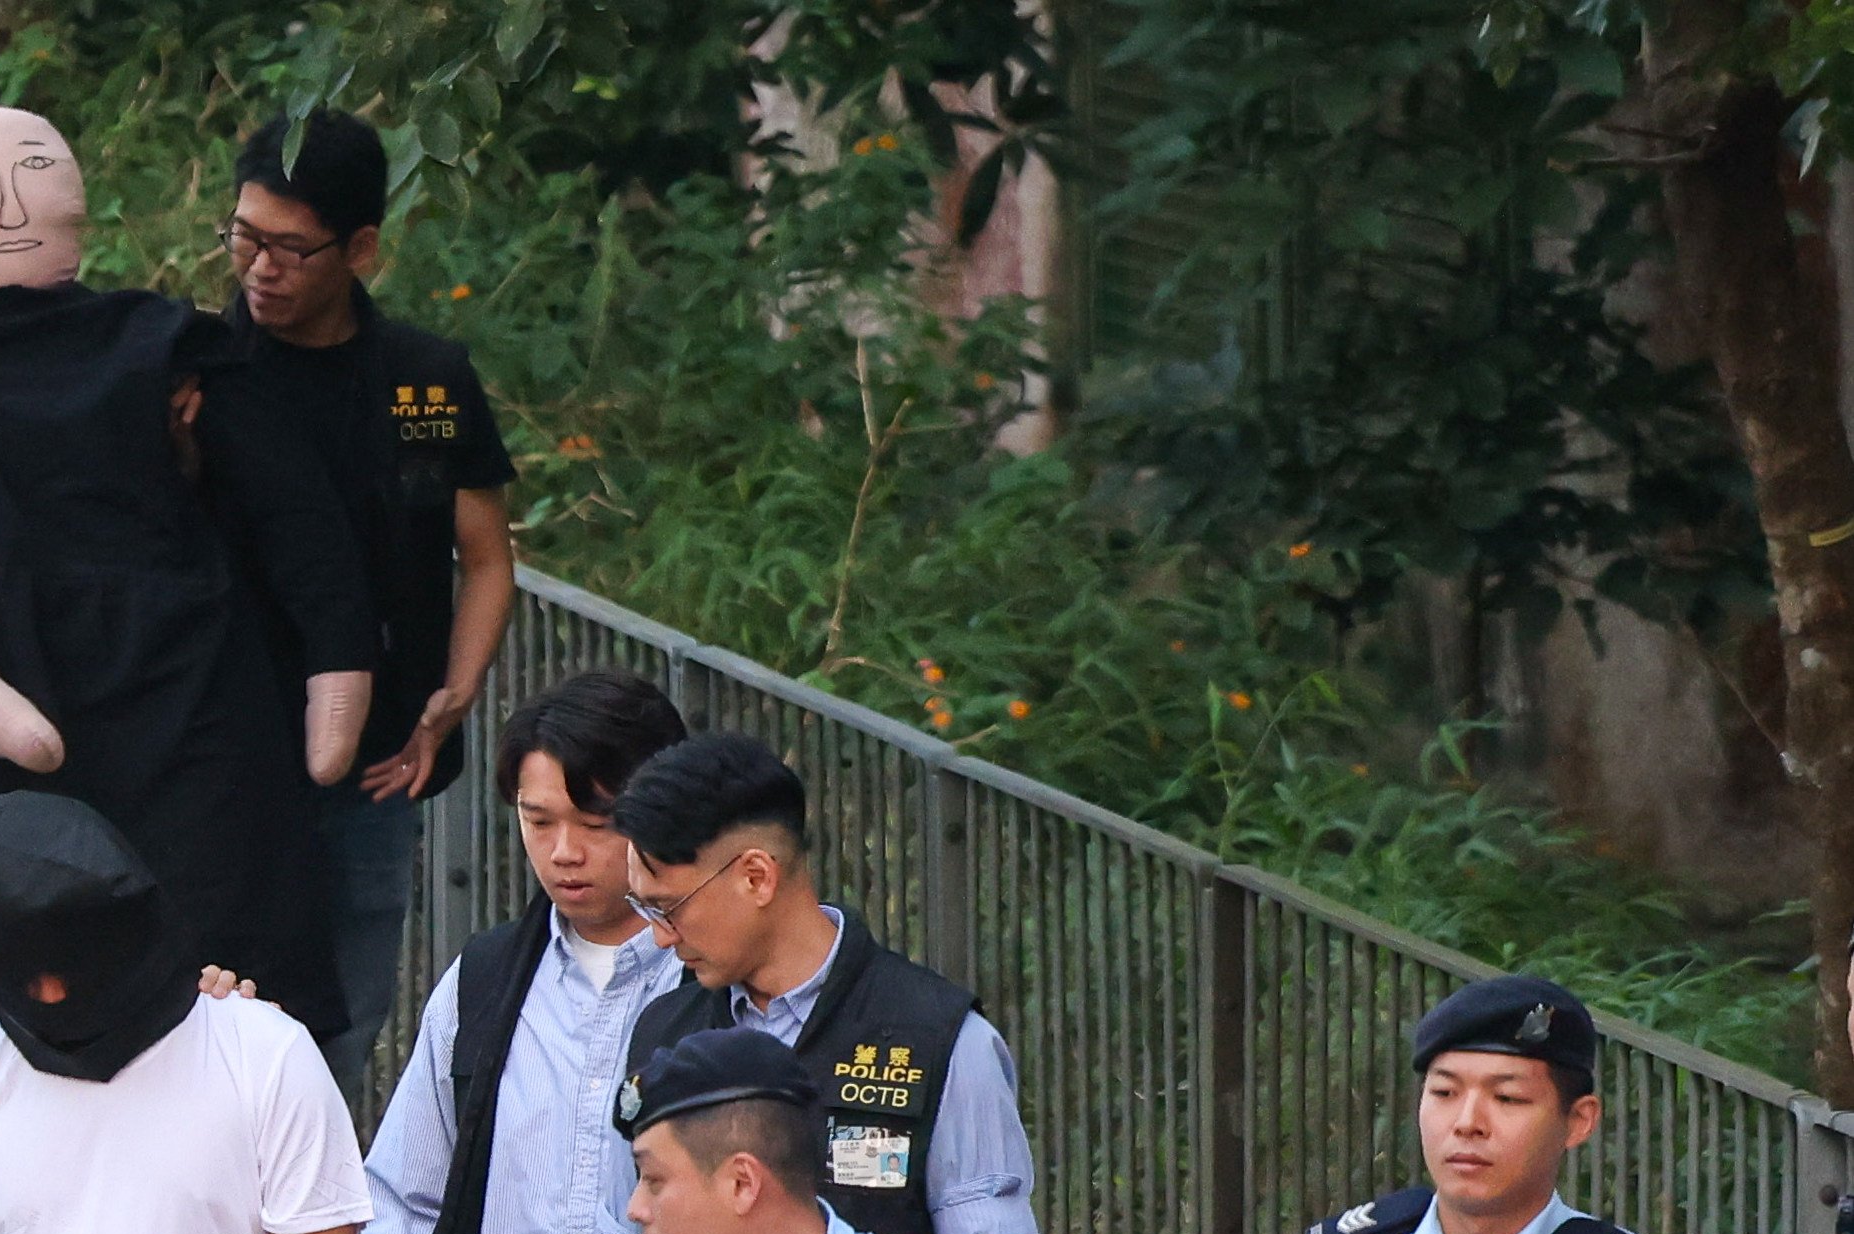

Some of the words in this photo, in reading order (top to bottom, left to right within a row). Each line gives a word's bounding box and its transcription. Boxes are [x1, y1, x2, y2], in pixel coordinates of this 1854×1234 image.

[400, 420, 454, 440] OCTB
[854, 1044, 911, 1067] 警察
[834, 1062, 924, 1084] POLICE
[841, 1083, 909, 1108] OCTB
